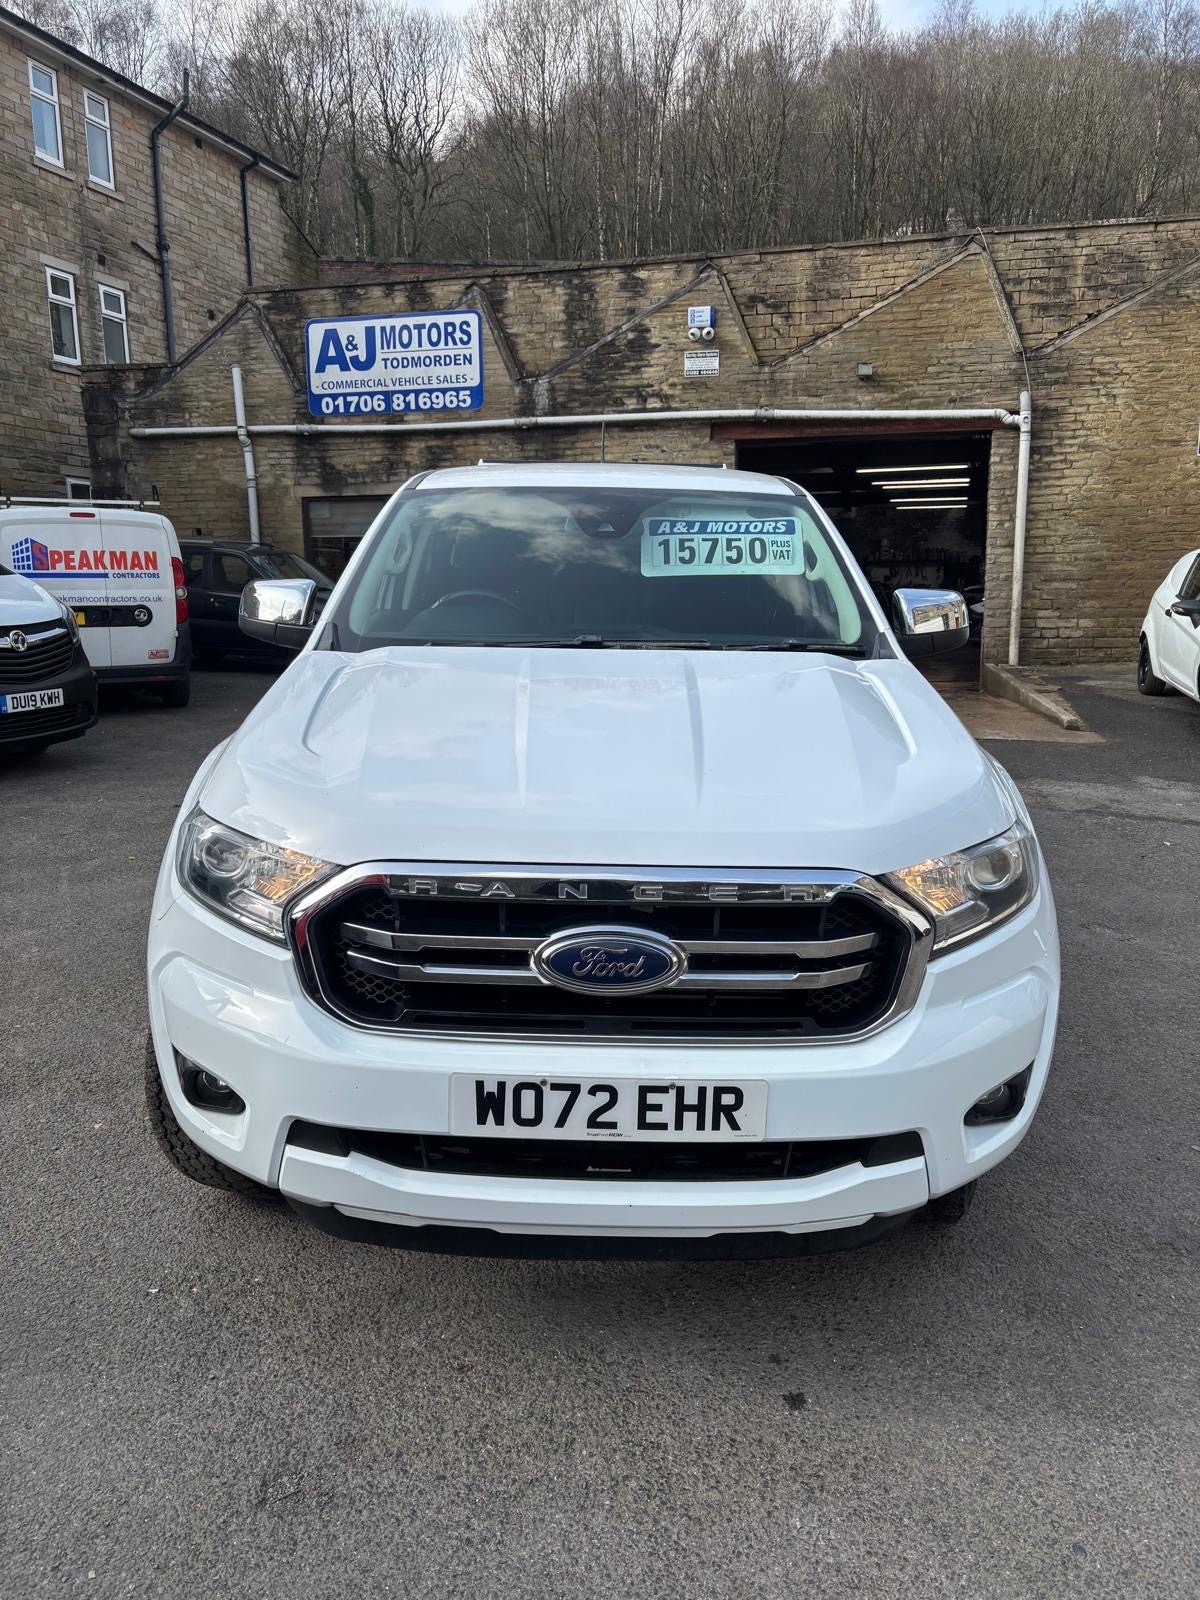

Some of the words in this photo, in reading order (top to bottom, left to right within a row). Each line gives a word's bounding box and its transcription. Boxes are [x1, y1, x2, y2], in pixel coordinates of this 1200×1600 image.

[315, 325, 377, 374] A&J
[380, 320, 472, 350] MOTORS
[381, 353, 473, 370] TODMORDEN
[321, 378, 389, 391] COMMERCIAL
[391, 375, 434, 387] VEHICLE
[436, 374, 468, 385] SALES
[321, 394, 386, 414] 01706
[392, 390, 472, 410] 816965
[706, 521, 787, 533] MOTORS
[658, 537, 767, 565] 15750
[770, 540, 791, 548] PLUS
[772, 549, 792, 561] VAT
[32, 543, 159, 571] SPEAKMAN
[11, 694, 38, 710] DU19
[39, 691, 61, 706] KWH
[408, 878, 816, 902] RANGER
[571, 946, 647, 978] Ford
[475, 1080, 619, 1130] WO72
[637, 1084, 744, 1132] EHR
